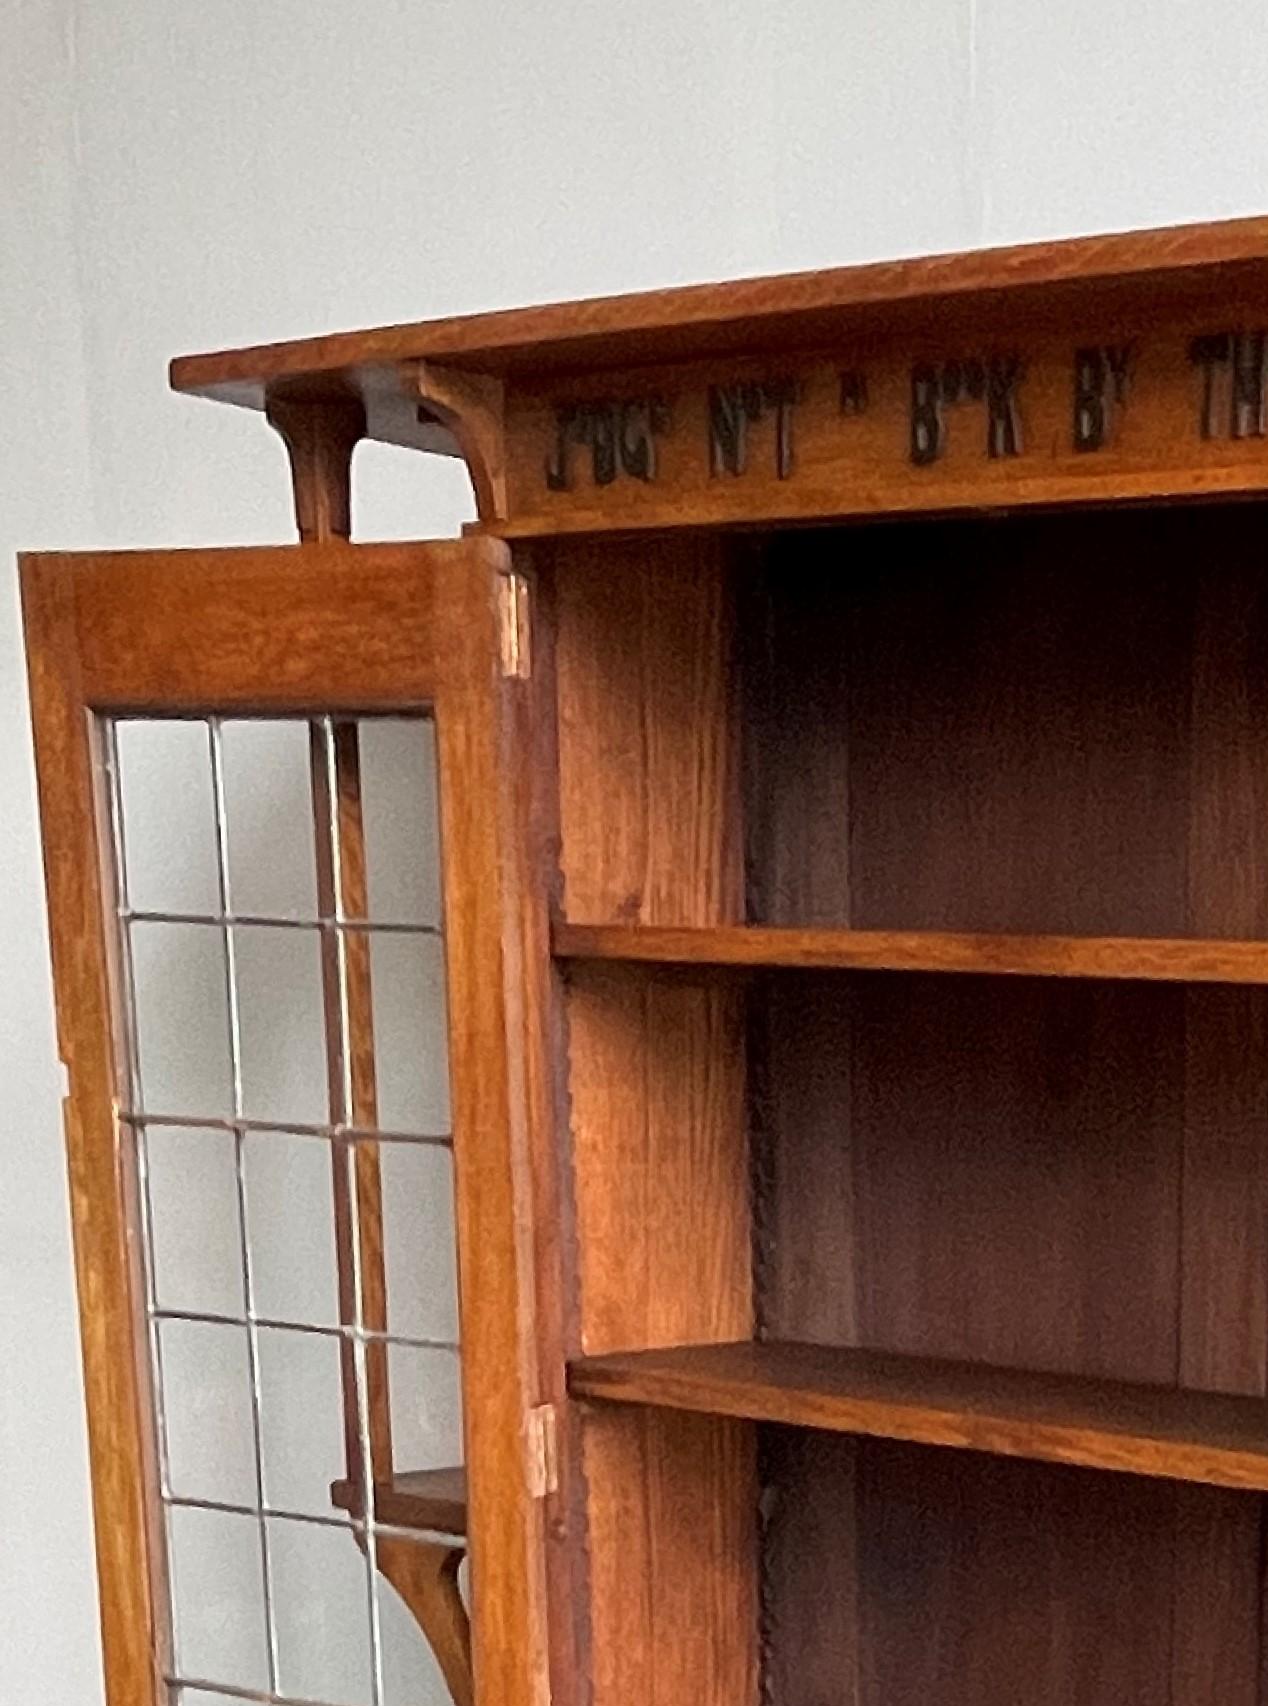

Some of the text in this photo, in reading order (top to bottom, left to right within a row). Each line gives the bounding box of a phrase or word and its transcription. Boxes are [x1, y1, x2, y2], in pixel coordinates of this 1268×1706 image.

[708, 380, 800, 480] NOT
[909, 352, 1023, 467] BOOK
[1072, 344, 1134, 452] BY
